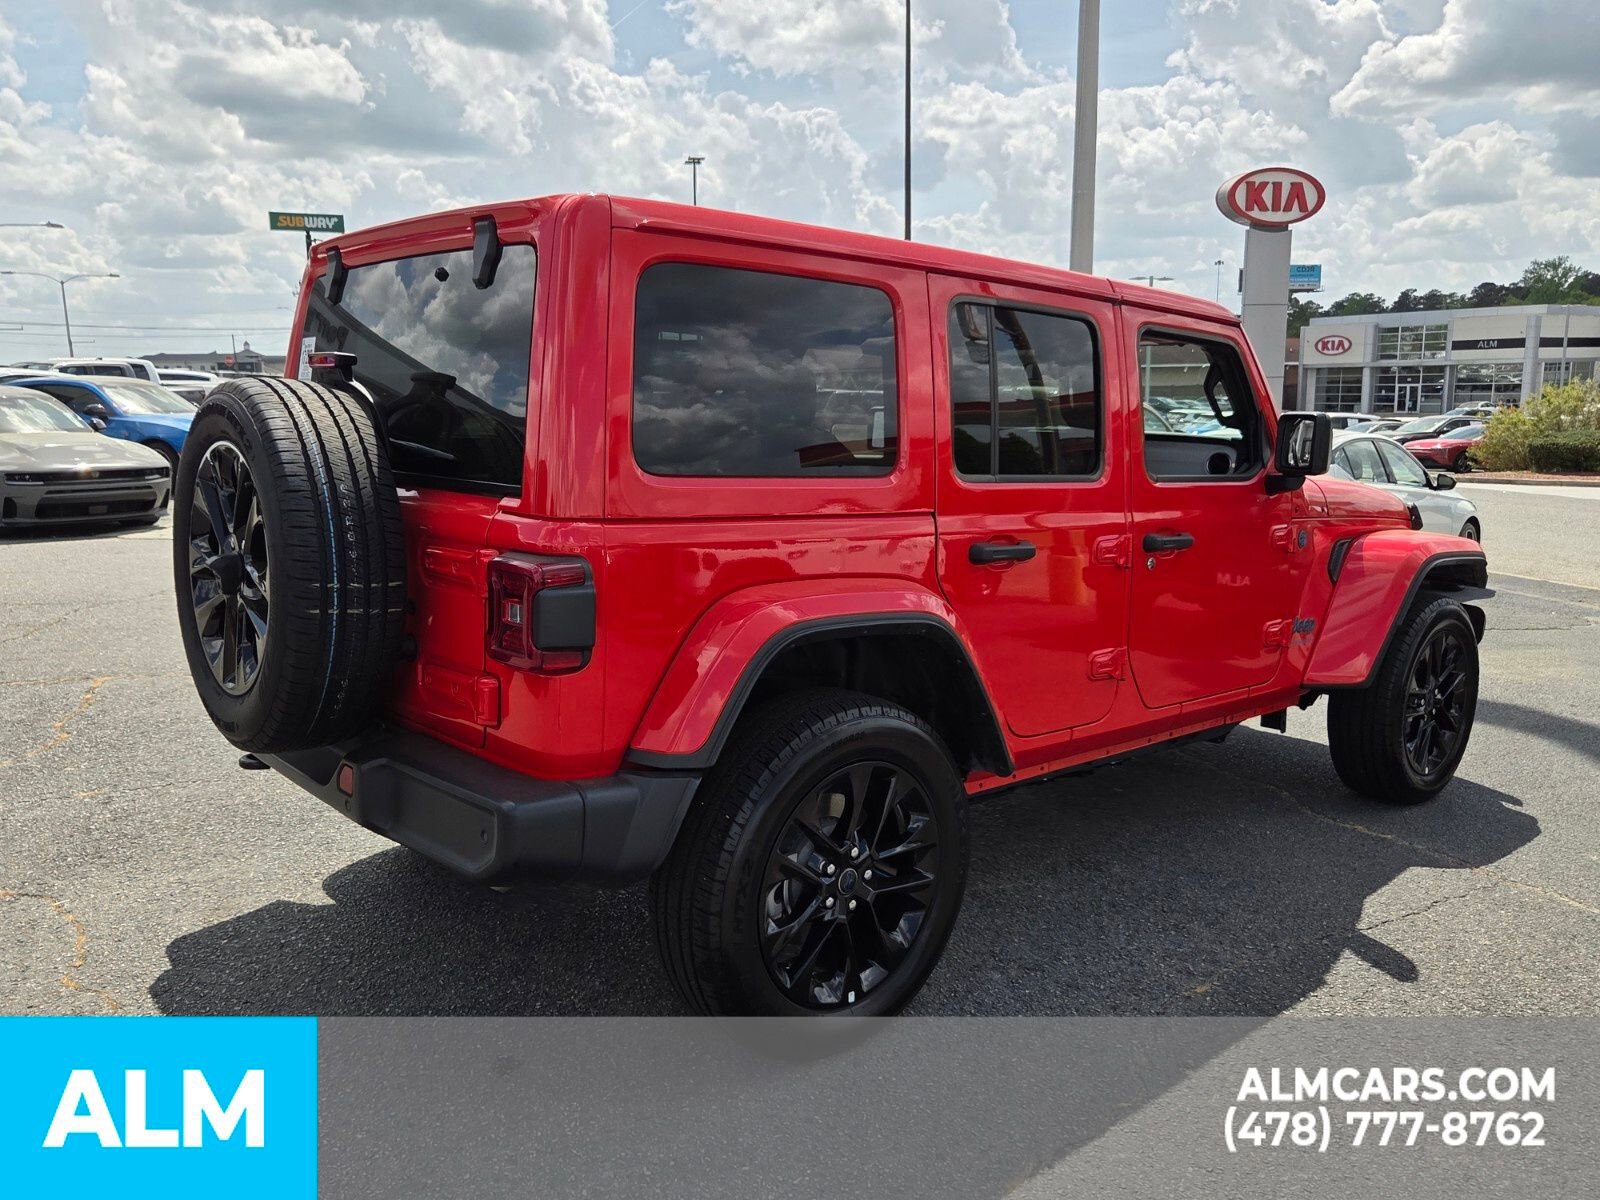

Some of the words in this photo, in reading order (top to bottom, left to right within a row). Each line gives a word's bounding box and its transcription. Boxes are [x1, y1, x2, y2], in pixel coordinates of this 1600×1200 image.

[1245, 181, 1309, 212] KIA
[277, 215, 338, 229] SUBWAY
[1321, 339, 1346, 351] KIA
[1477, 340, 1498, 349] ALM
